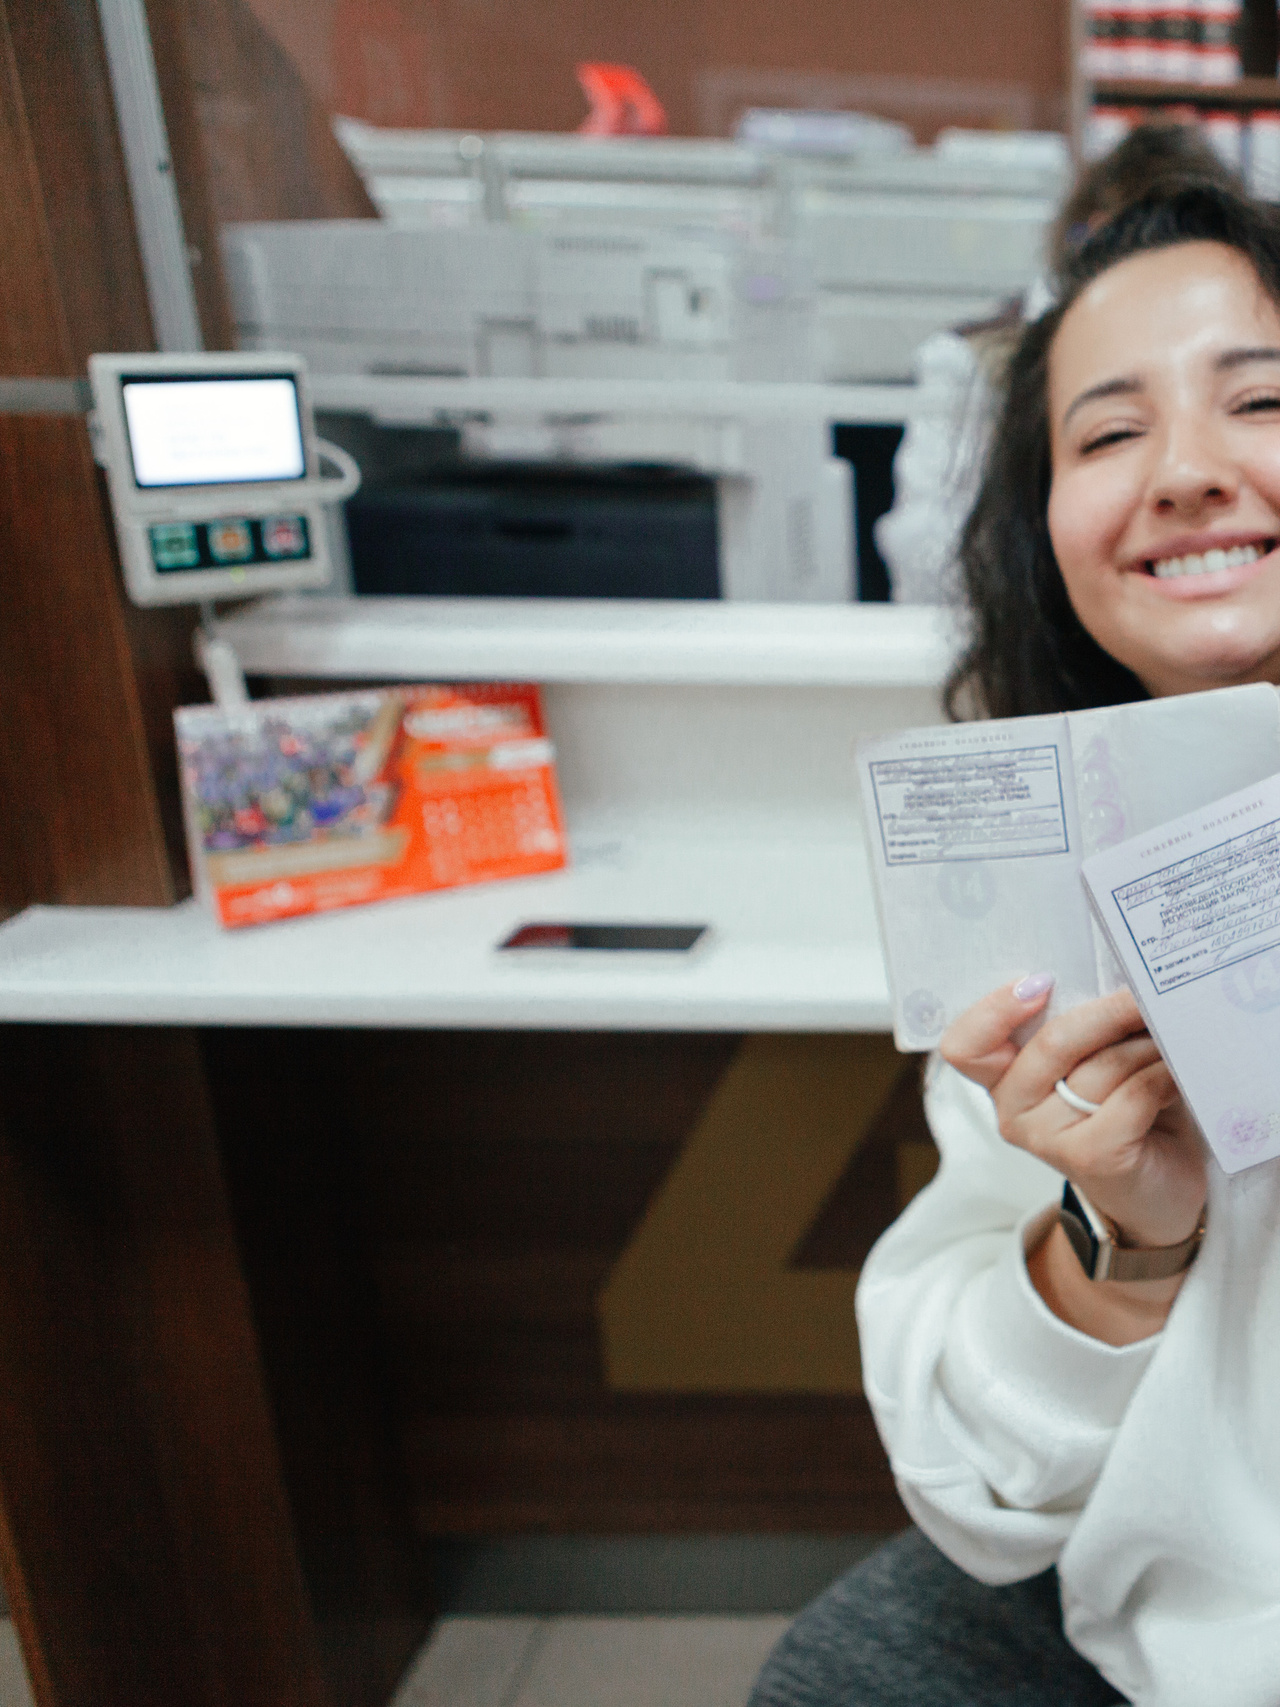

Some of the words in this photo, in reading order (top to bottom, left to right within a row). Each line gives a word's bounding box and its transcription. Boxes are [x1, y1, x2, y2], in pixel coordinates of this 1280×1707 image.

[1138, 828, 1194, 859] СЕМЕЙНОЕ
[1201, 797, 1266, 832] ПОЛОЖЕНИЕ
[1158, 887, 1220, 919] ПРОИЗВЕДЕНА
[1161, 895, 1220, 928] РЕГИСТРАЦИЯ
[1219, 872, 1277, 903] ЗАКЛЮЧЕНИЯ
